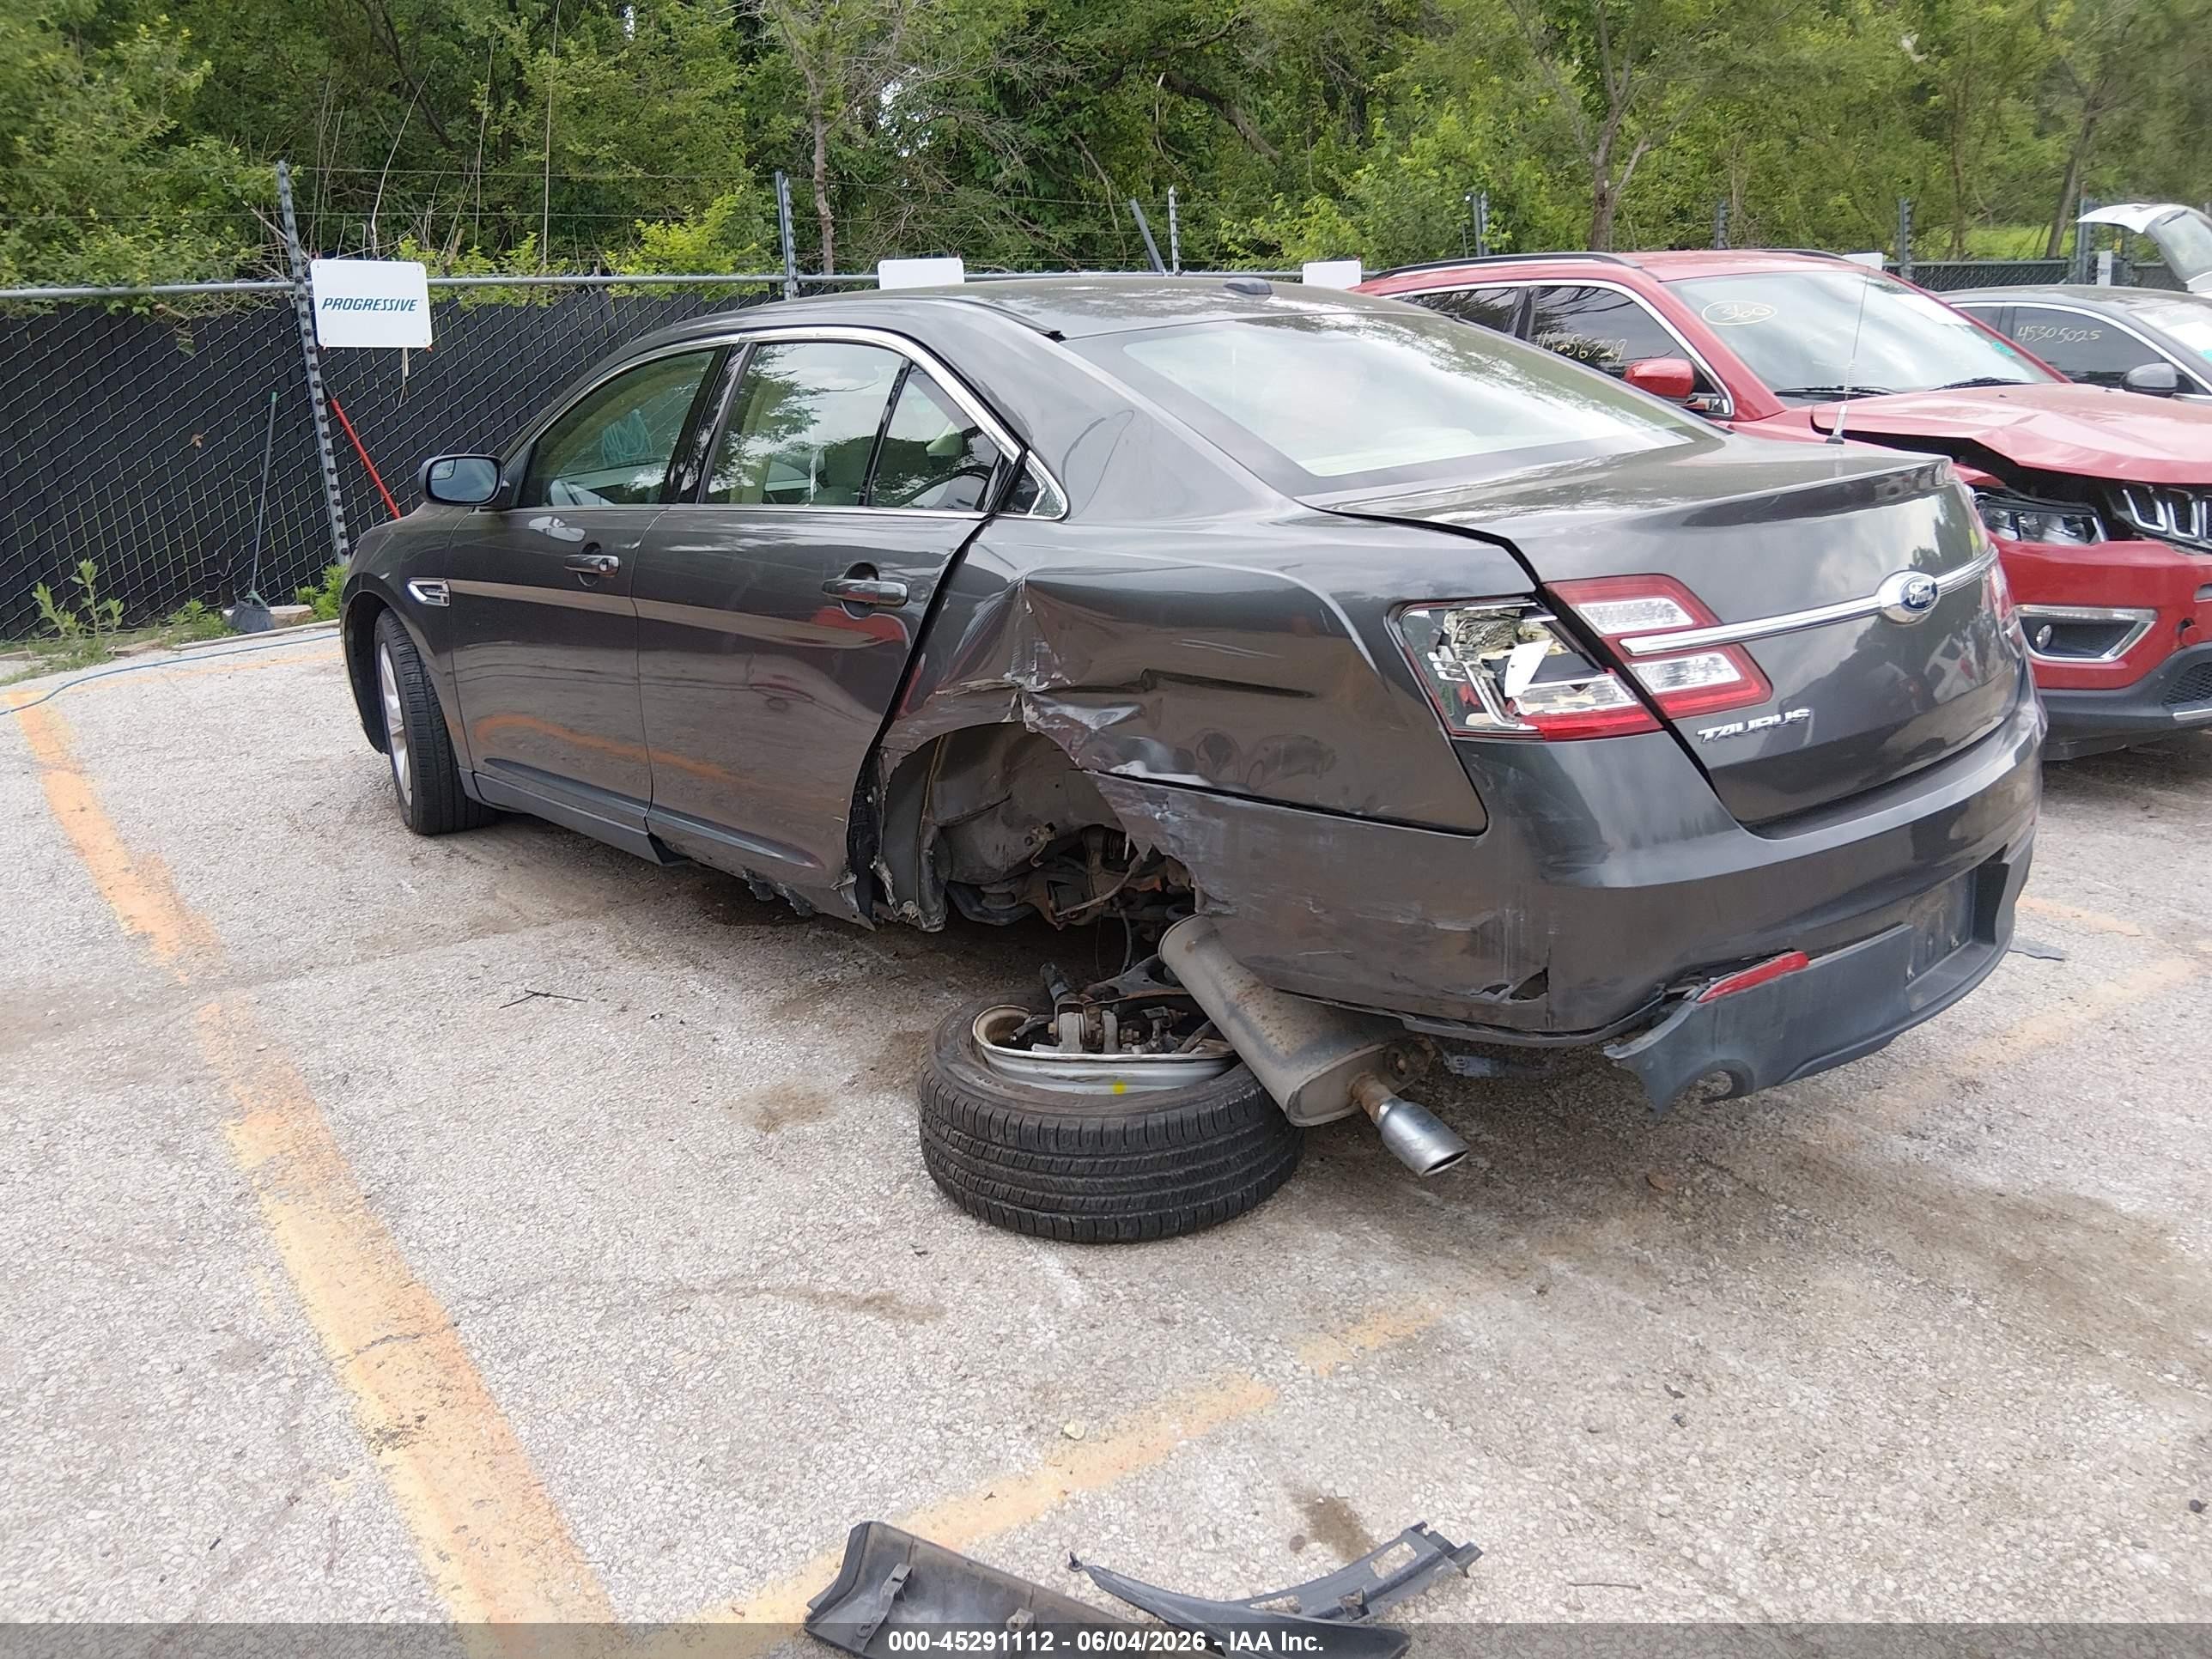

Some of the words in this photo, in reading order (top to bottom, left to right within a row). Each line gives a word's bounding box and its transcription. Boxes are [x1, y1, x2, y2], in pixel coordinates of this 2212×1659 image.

[322, 297, 417, 312] PROGRESSIVE
[2016, 325, 2103, 343] 45305025
[1697, 708, 1811, 744] TAURUS
